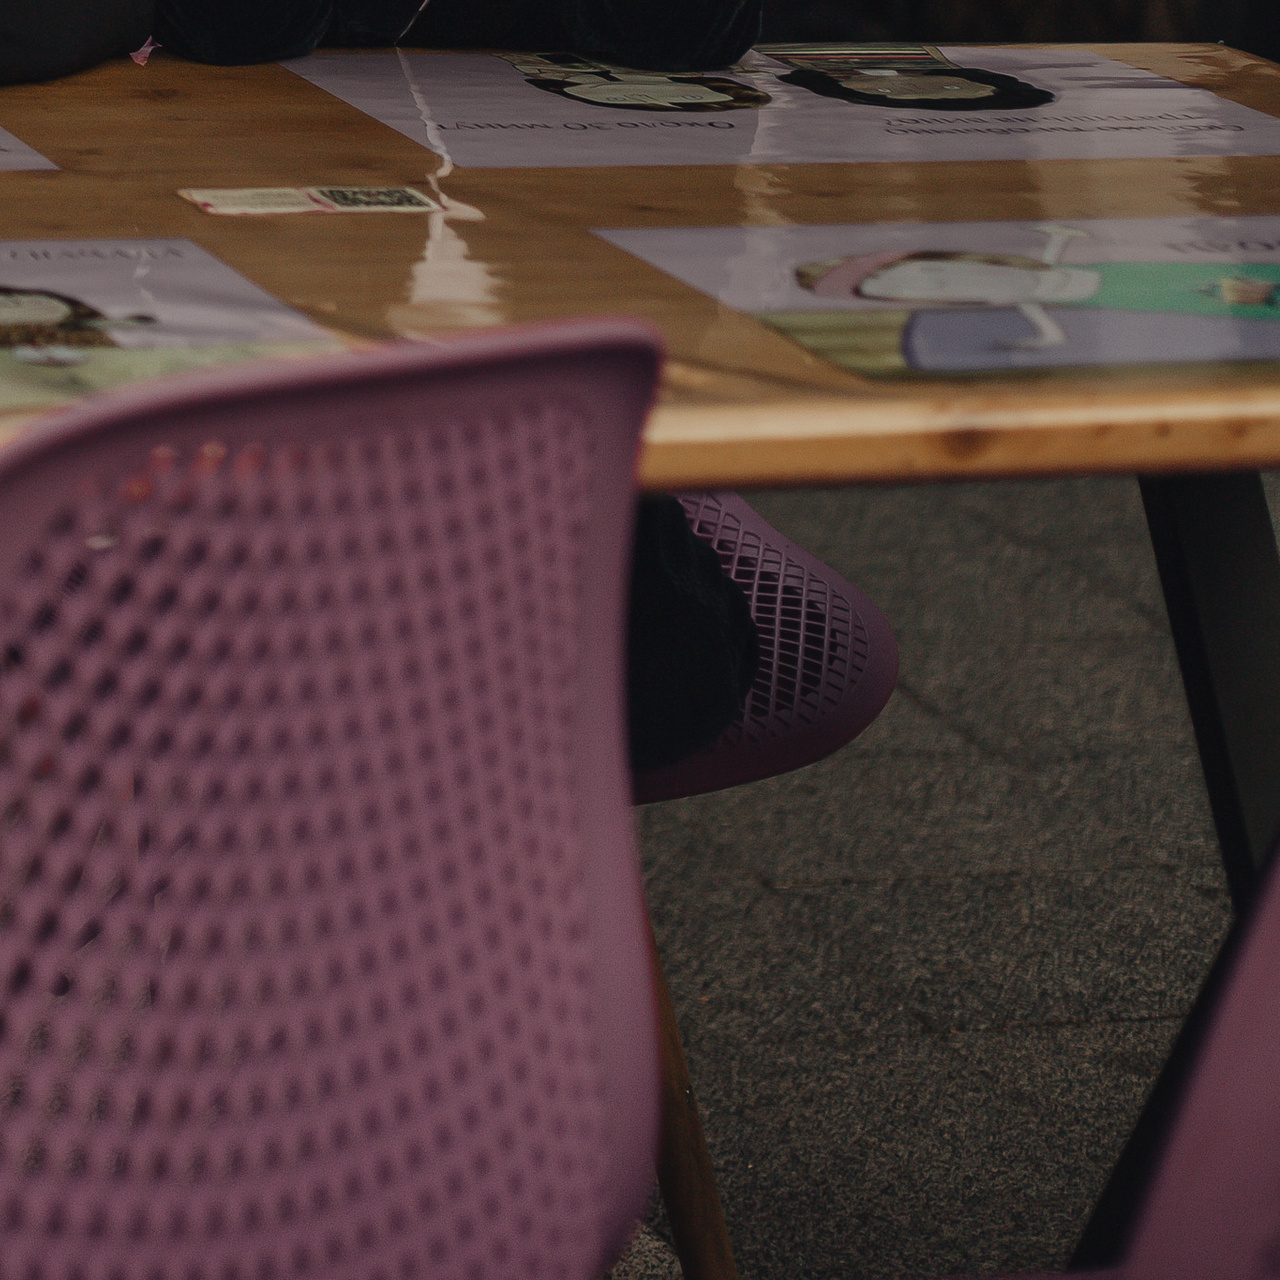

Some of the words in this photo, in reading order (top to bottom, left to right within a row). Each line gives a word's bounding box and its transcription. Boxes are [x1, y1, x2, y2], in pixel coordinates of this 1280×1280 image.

[433, 120, 552, 131] минут
[563, 121, 607, 131] 30
[616, 120, 735, 130] Около
[882, 117, 989, 126] вино?
[885, 125, 1032, 136] обычно
